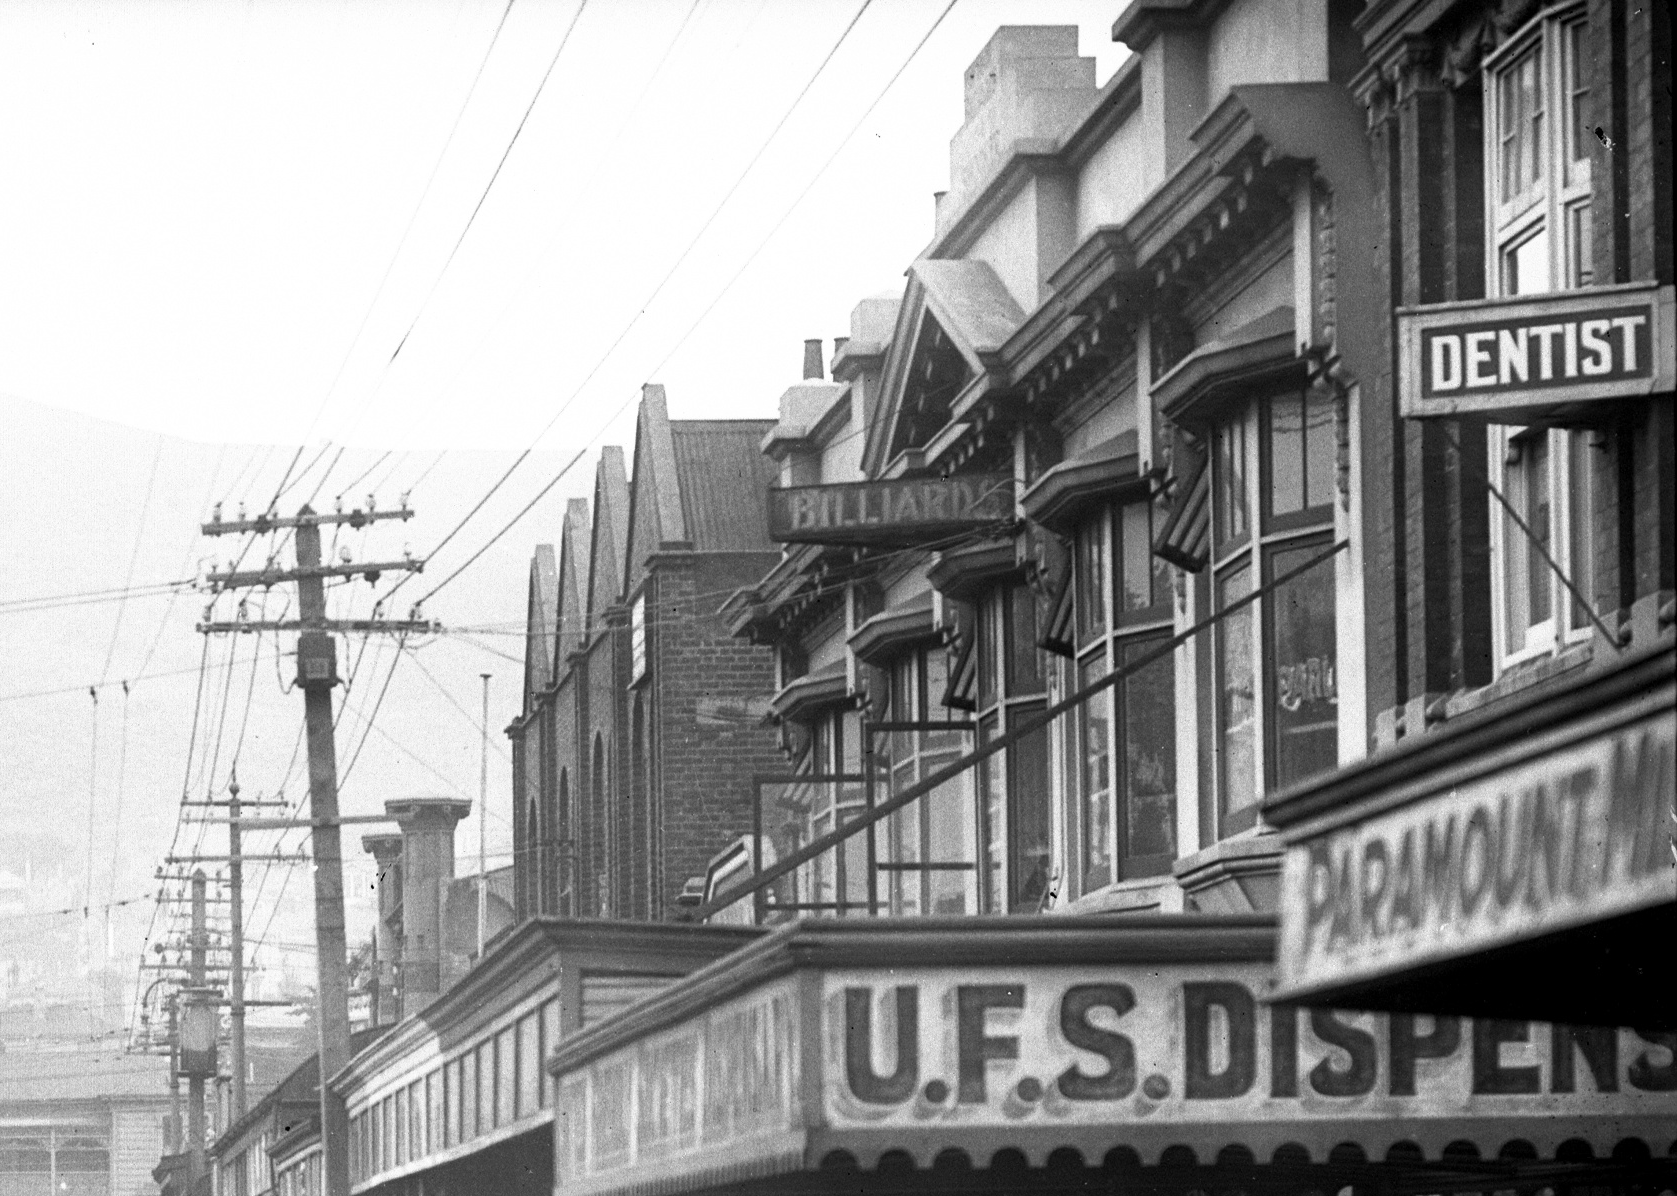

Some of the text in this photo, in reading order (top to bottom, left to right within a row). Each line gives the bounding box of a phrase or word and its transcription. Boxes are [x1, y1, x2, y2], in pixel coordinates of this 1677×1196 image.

[1430, 315, 1647, 393] DENTIST
[1297, 766, 1599, 974] PARAMOUNT
[844, 980, 1171, 1105] U.F.S.
